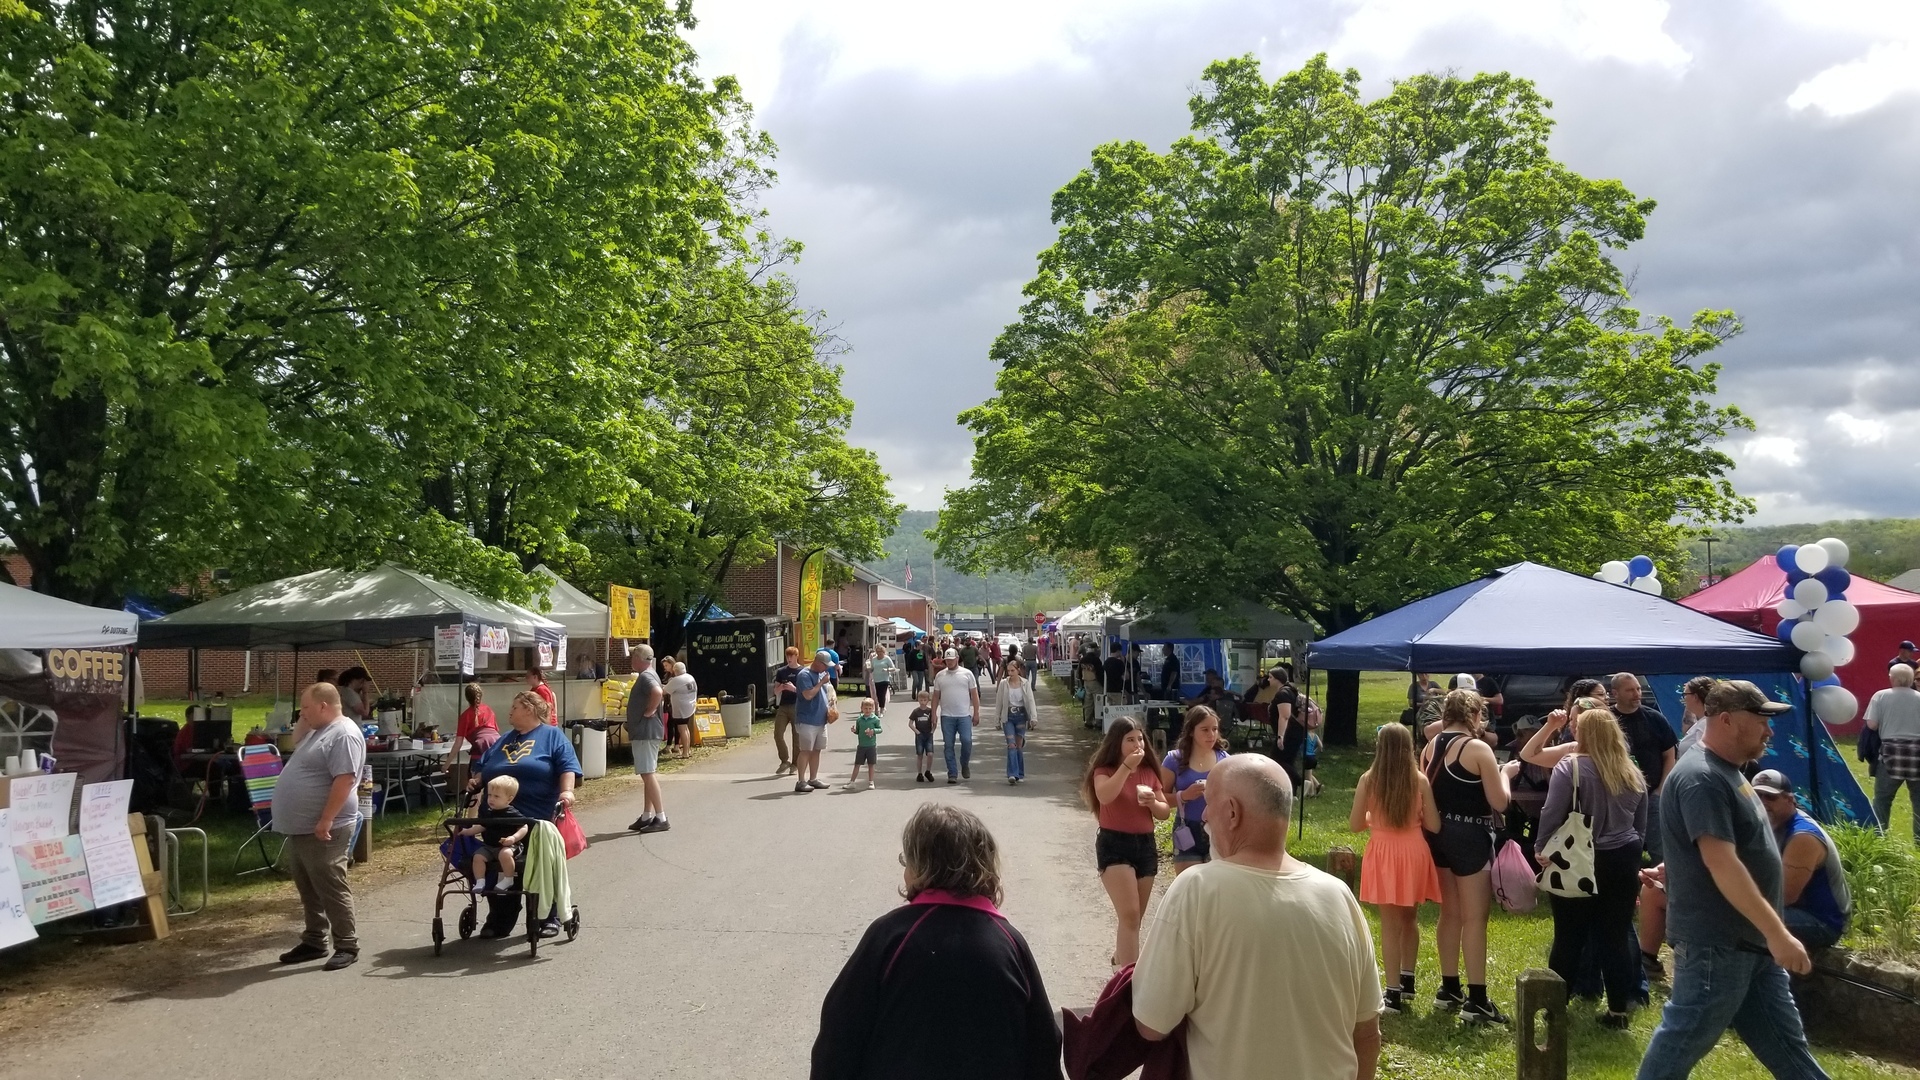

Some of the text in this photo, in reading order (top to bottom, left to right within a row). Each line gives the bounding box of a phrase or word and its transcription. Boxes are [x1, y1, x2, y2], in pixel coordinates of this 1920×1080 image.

[805, 562, 818, 641] LEMONADE
[715, 635, 734, 643] LEMON
[737, 634, 751, 642] TREE
[48, 648, 124, 682] COFFEE
